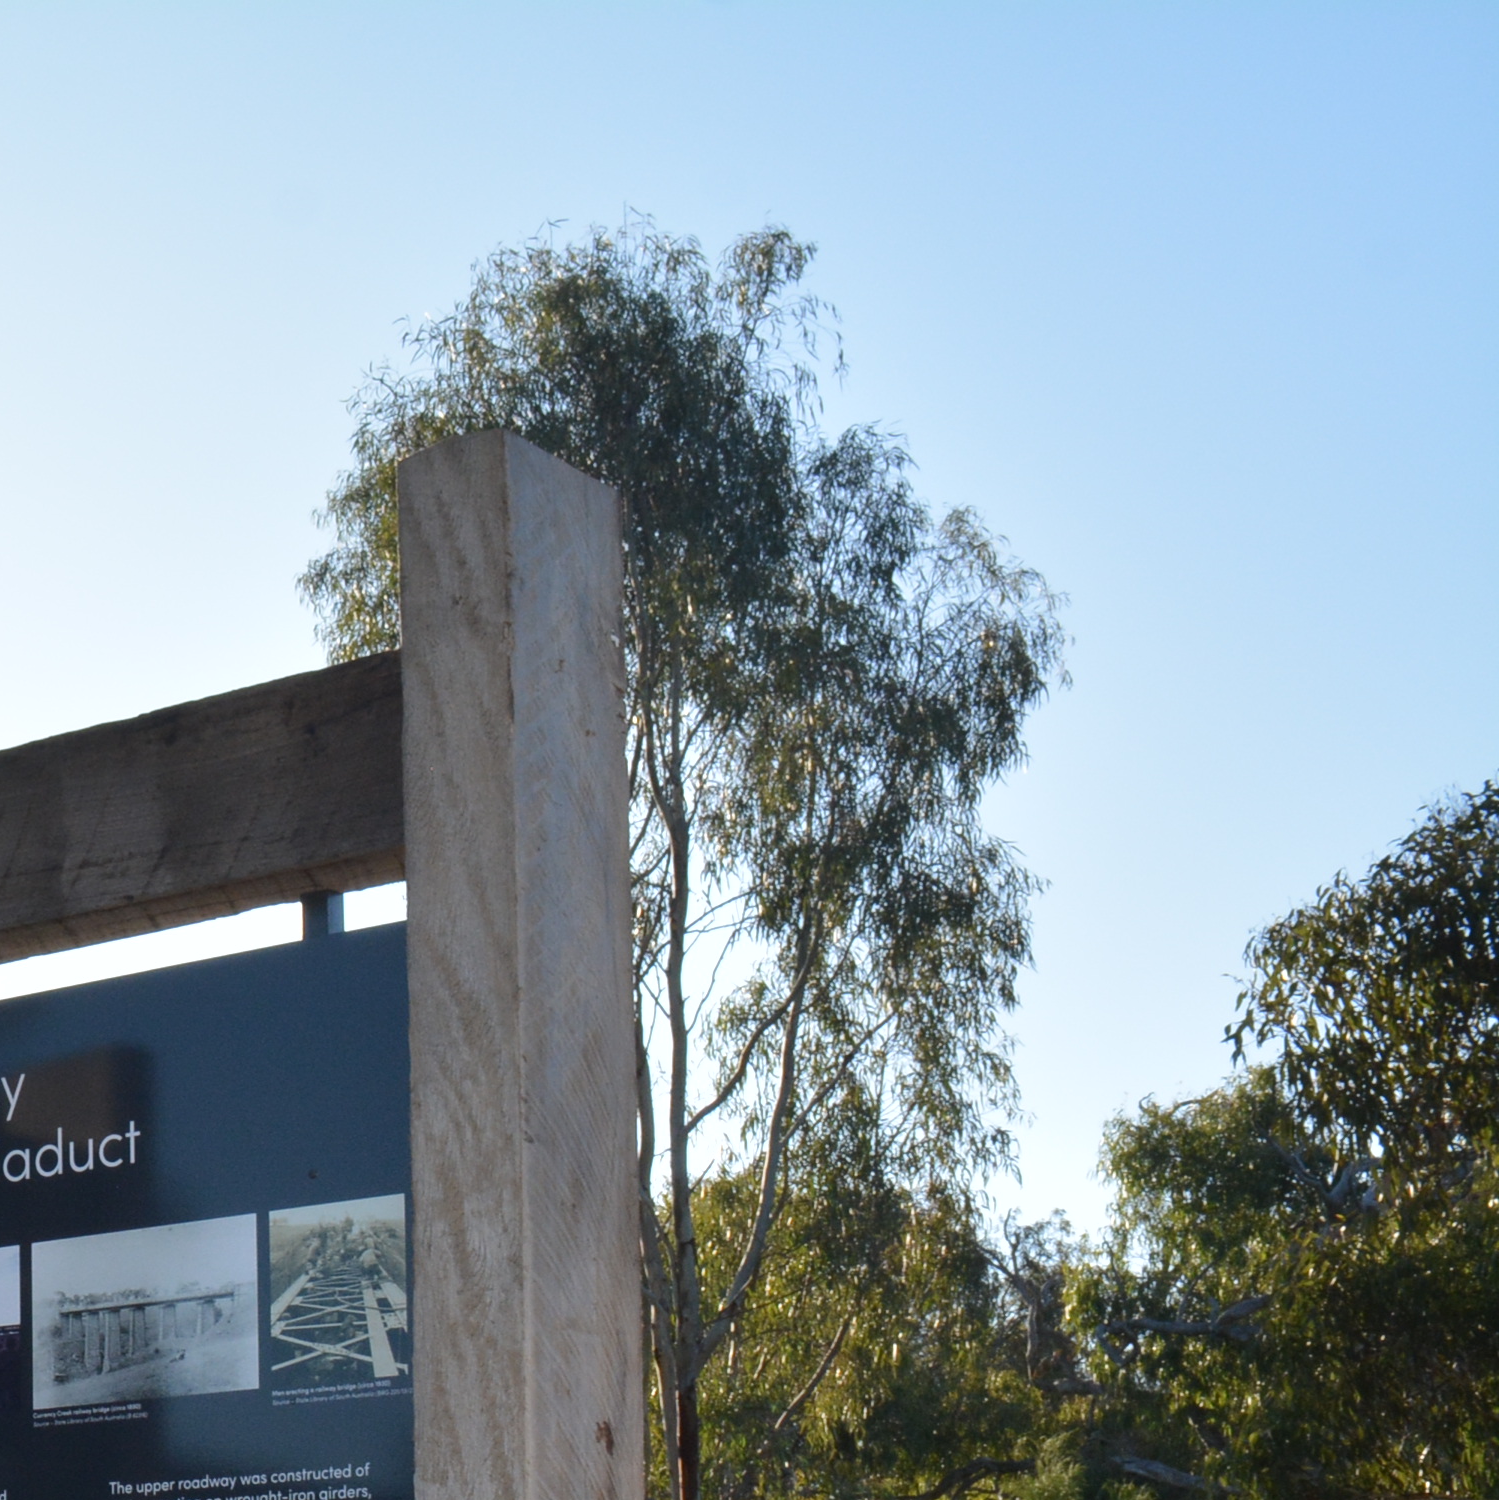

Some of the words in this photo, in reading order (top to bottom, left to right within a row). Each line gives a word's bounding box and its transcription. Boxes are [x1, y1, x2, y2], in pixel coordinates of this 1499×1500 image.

[109, 1480, 133, 1495] The
[136, 1480, 175, 1496] upper
[178, 1473, 236, 1490] roadway
[240, 1473, 267, 1485] was
[271, 1463, 351, 1483] constructed
[355, 1461, 370, 1477] of
